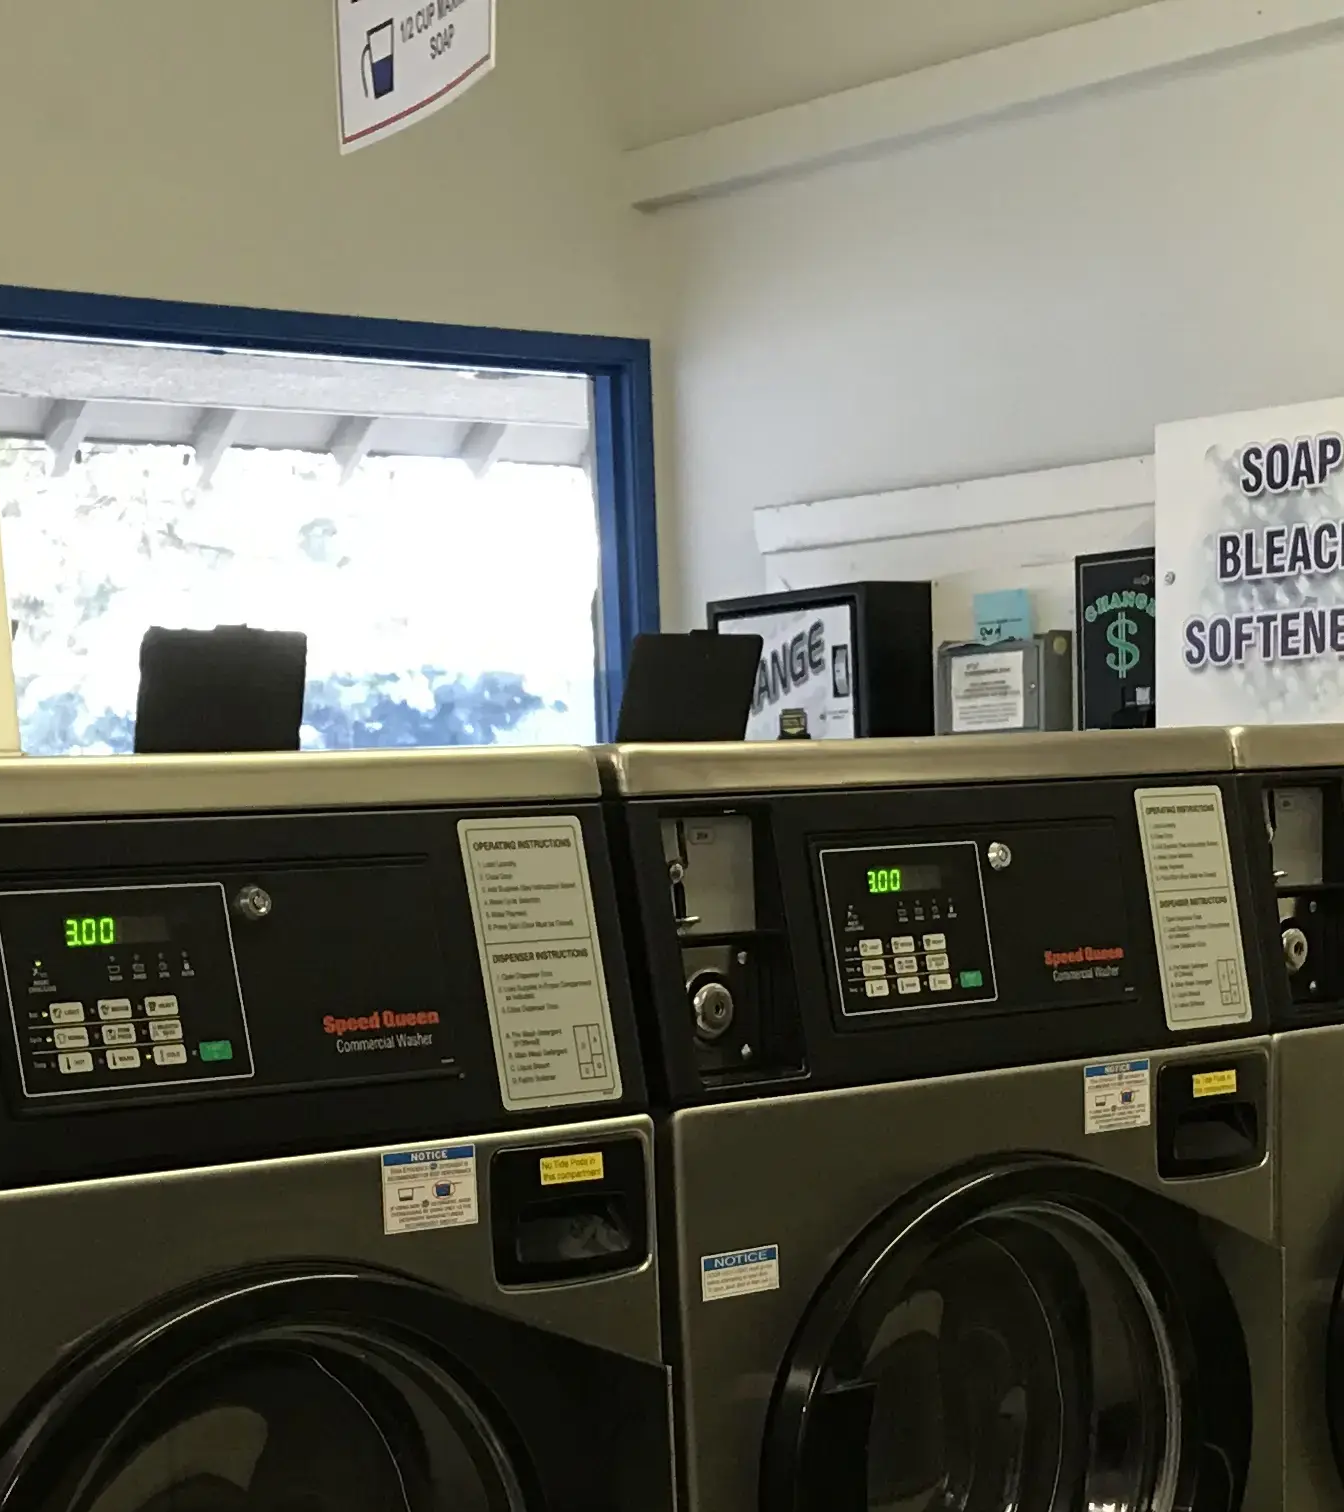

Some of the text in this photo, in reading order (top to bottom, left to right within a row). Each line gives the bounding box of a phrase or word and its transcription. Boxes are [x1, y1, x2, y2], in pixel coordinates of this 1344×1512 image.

[415, 2, 435, 33] CUP
[430, 24, 455, 60] SOAP
[1241, 436, 1342, 493] SOAP
[750, 618, 826, 716] ANGE
[473, 838, 572, 852] OPERATING INSTRUCTIONS
[66, 917, 114, 946] 3.00
[492, 948, 589, 964] DISPENSER INSTRUCTIONS
[1044, 946, 1124, 968] Speed Queen
[323, 1010, 440, 1036] Speed Queen
[336, 1033, 433, 1053] Commercial Washer
[410, 1150, 448, 1162] NOTICE
[714, 1250, 768, 1268] NOTICE
